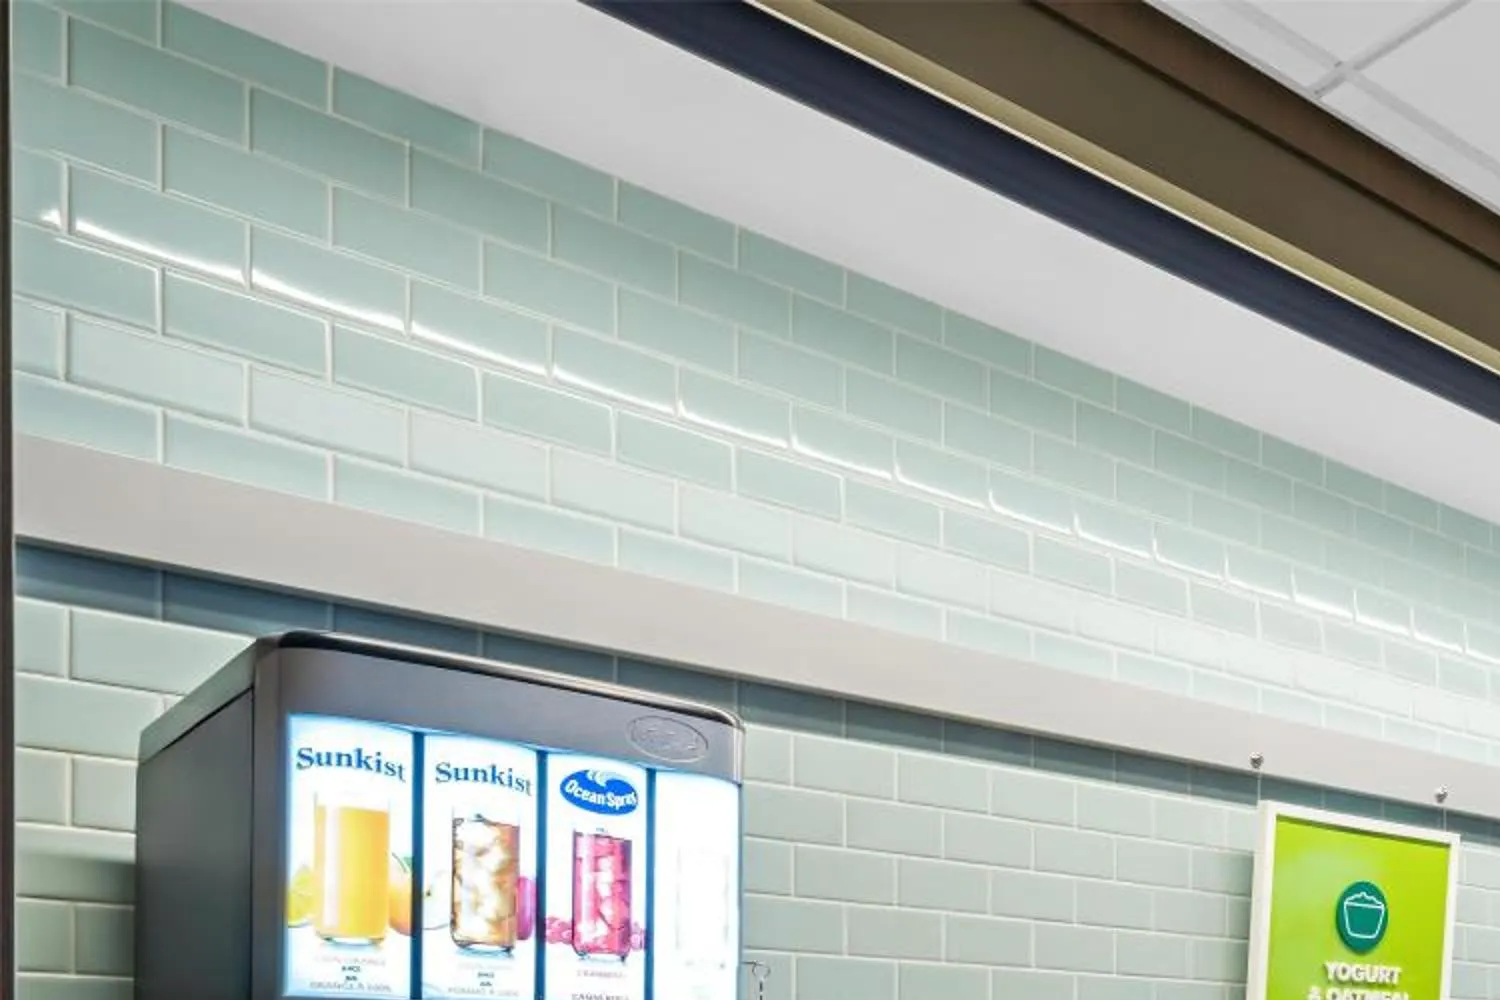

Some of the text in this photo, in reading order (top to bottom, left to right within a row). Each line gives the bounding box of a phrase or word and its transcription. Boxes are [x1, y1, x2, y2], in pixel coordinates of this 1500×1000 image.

[296, 747, 406, 783] Sunkist
[435, 761, 532, 797] Sunkist
[565, 779, 605, 805] Ocean
[1323, 961, 1402, 986] YOGURT
